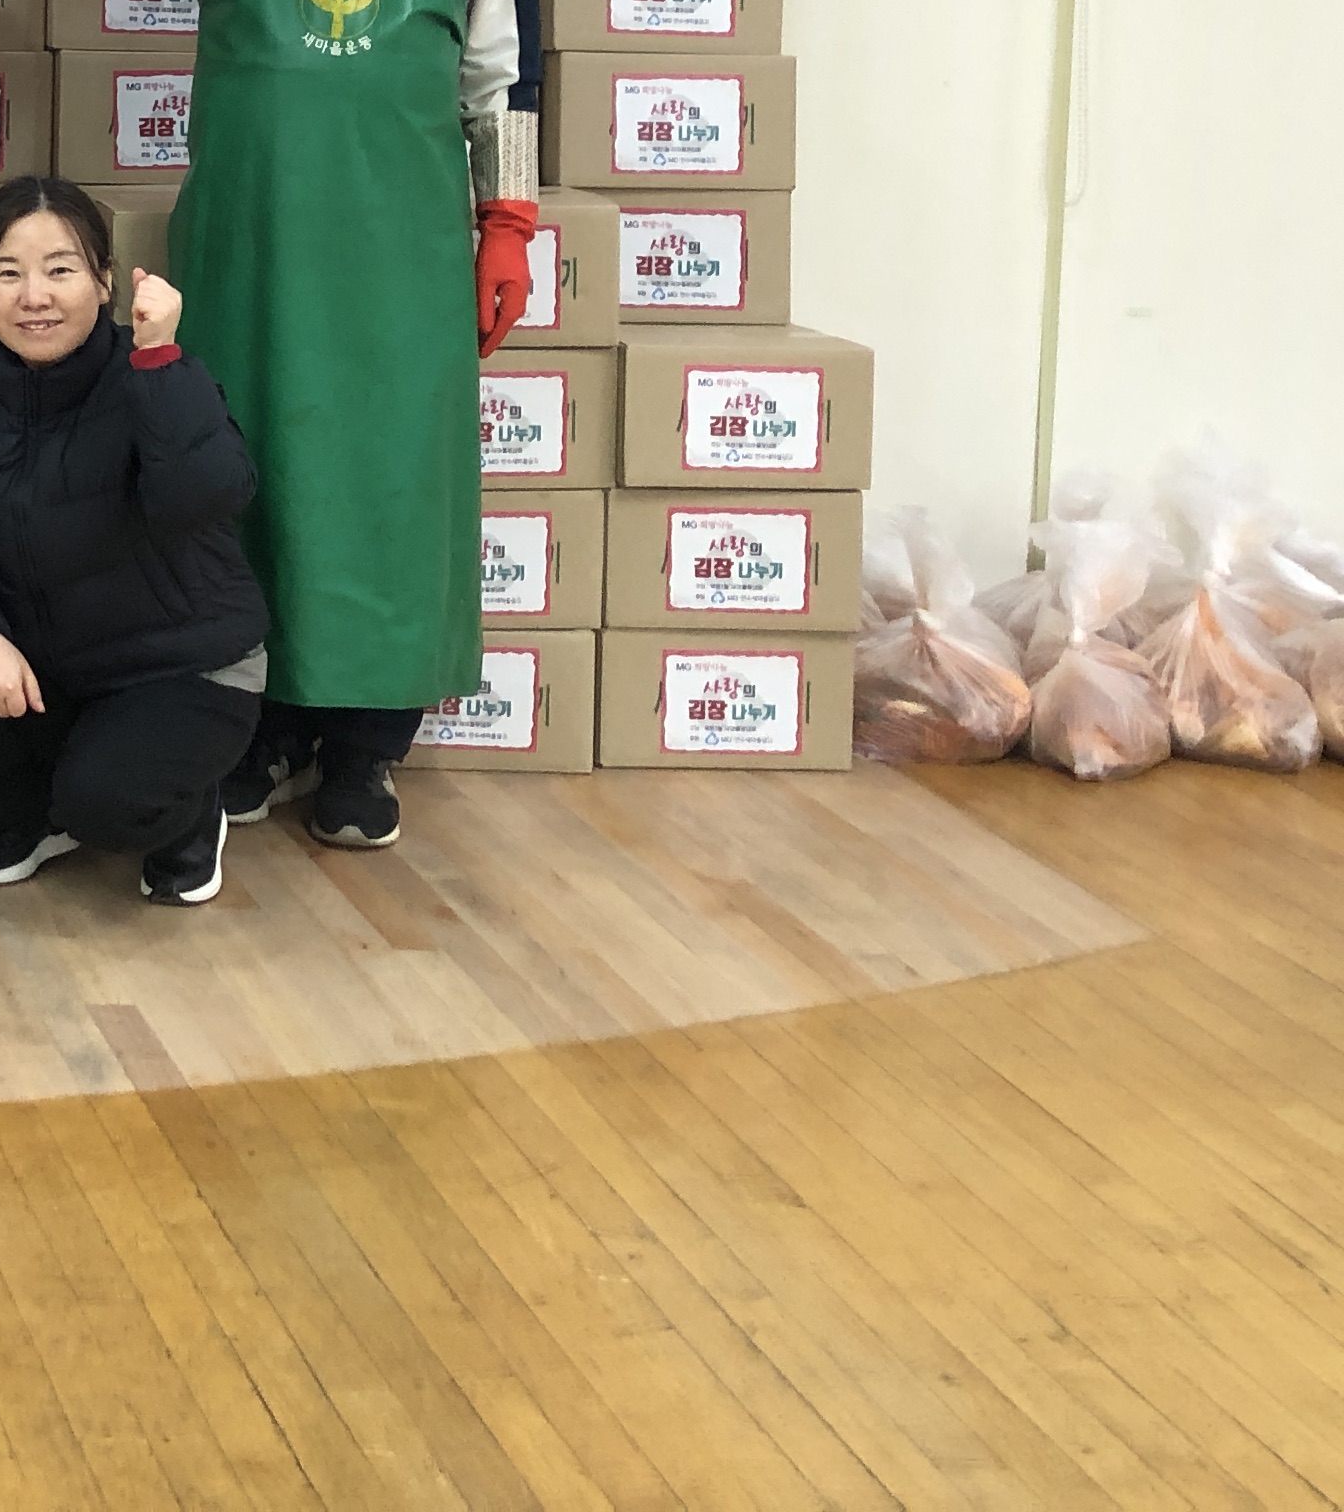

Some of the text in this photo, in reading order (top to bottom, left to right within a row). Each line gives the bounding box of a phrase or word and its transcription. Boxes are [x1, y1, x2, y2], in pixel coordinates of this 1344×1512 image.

[302, 31, 372, 56] 새마을운동
[125, 82, 142, 91] MG
[152, 96, 189, 117] 사랑
[651, 100, 699, 122] 사랑의
[138, 117, 176, 137] 김장
[637, 121, 719, 142] 김장 나누기
[650, 235, 700, 256] 사랑의
[636, 256, 719, 276] 김장 나누기
[724, 394, 776, 416] 사랑의
[498, 424, 542, 443] 나누기
[709, 415, 796, 437] 김장 나누기
[709, 536, 762, 558] 사랑의
[481, 563, 525, 582] 나누기
[694, 557, 782, 579] 김장 나누기
[703, 678, 755, 700] 사랑의
[466, 699, 512, 717] 나누기
[688, 699, 775, 721] 김장 나누기
